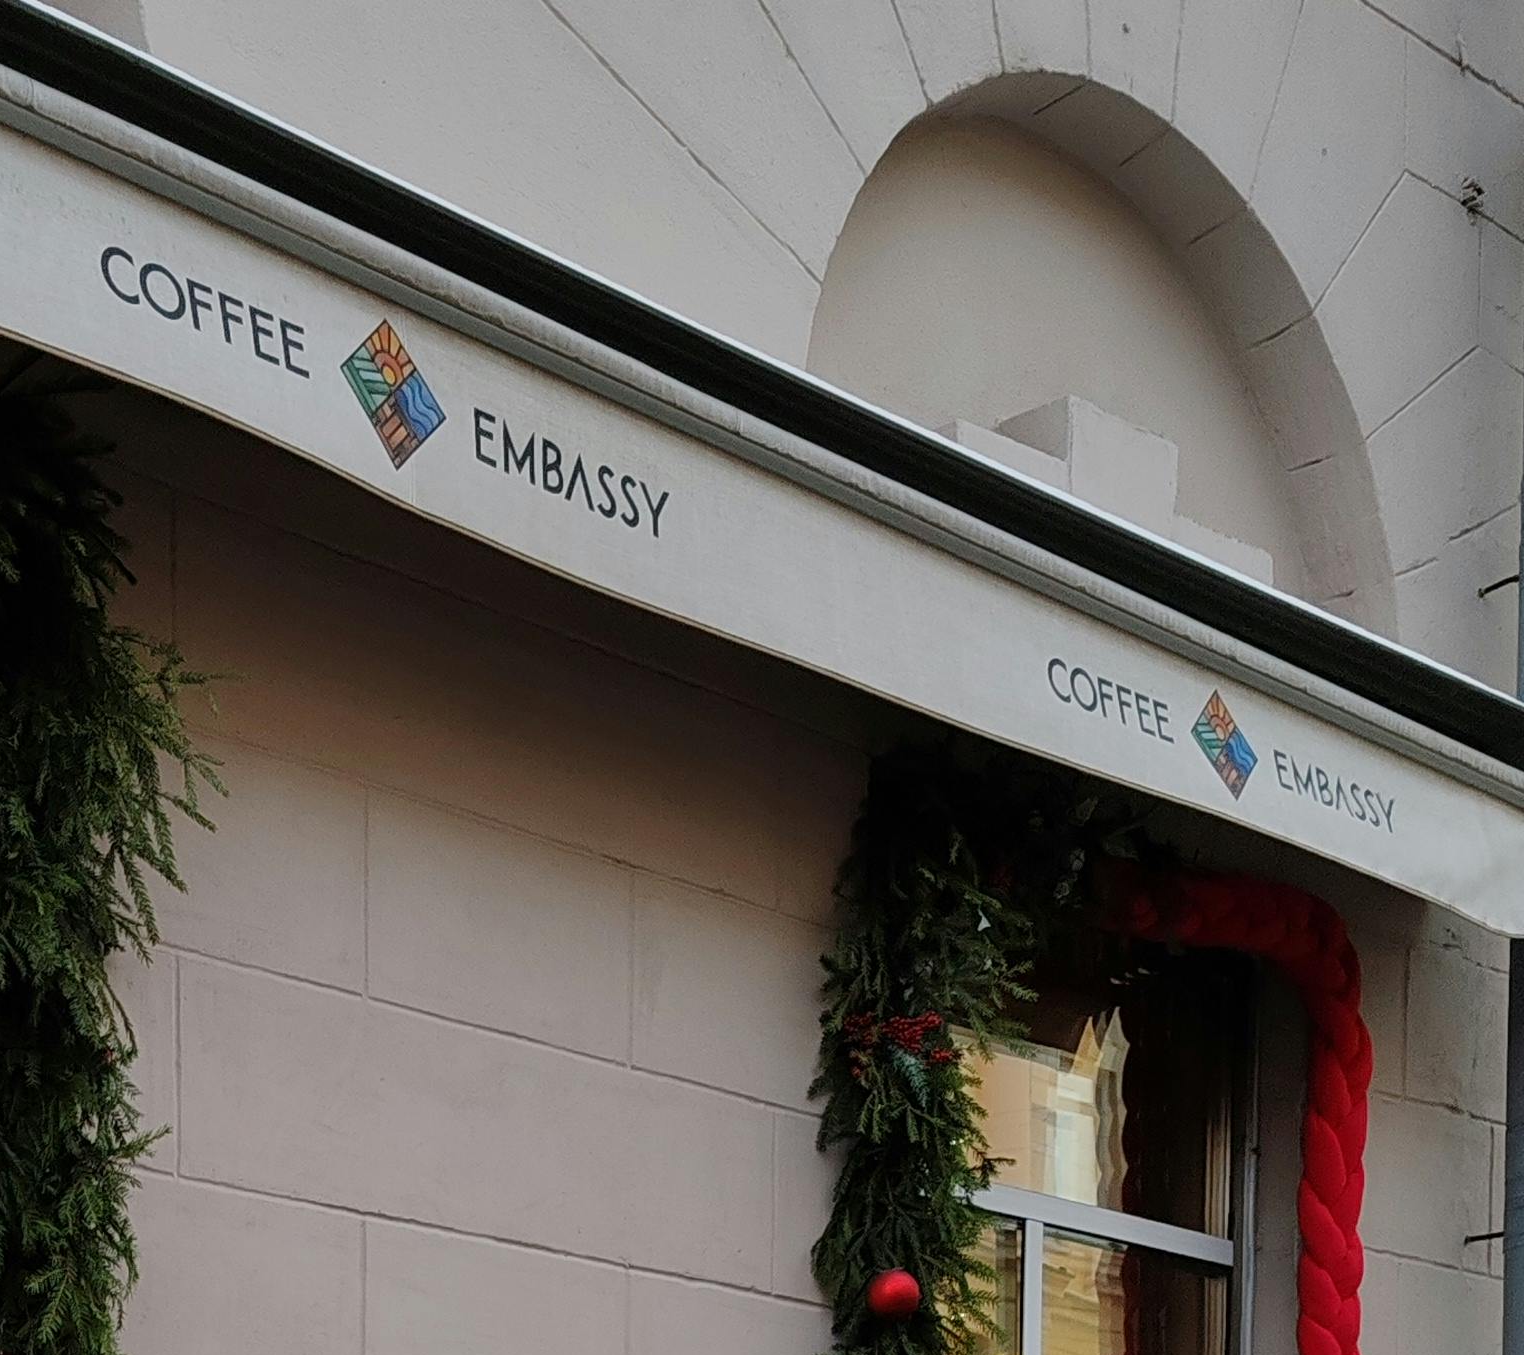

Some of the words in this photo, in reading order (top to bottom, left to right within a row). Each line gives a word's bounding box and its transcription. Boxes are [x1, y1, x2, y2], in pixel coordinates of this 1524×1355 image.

[100, 246, 310, 379] COFFEE
[474, 407, 670, 538] EMBASSY
[1047, 658, 1175, 744] COFFEE
[1273, 749, 1394, 833] EMBASSY
